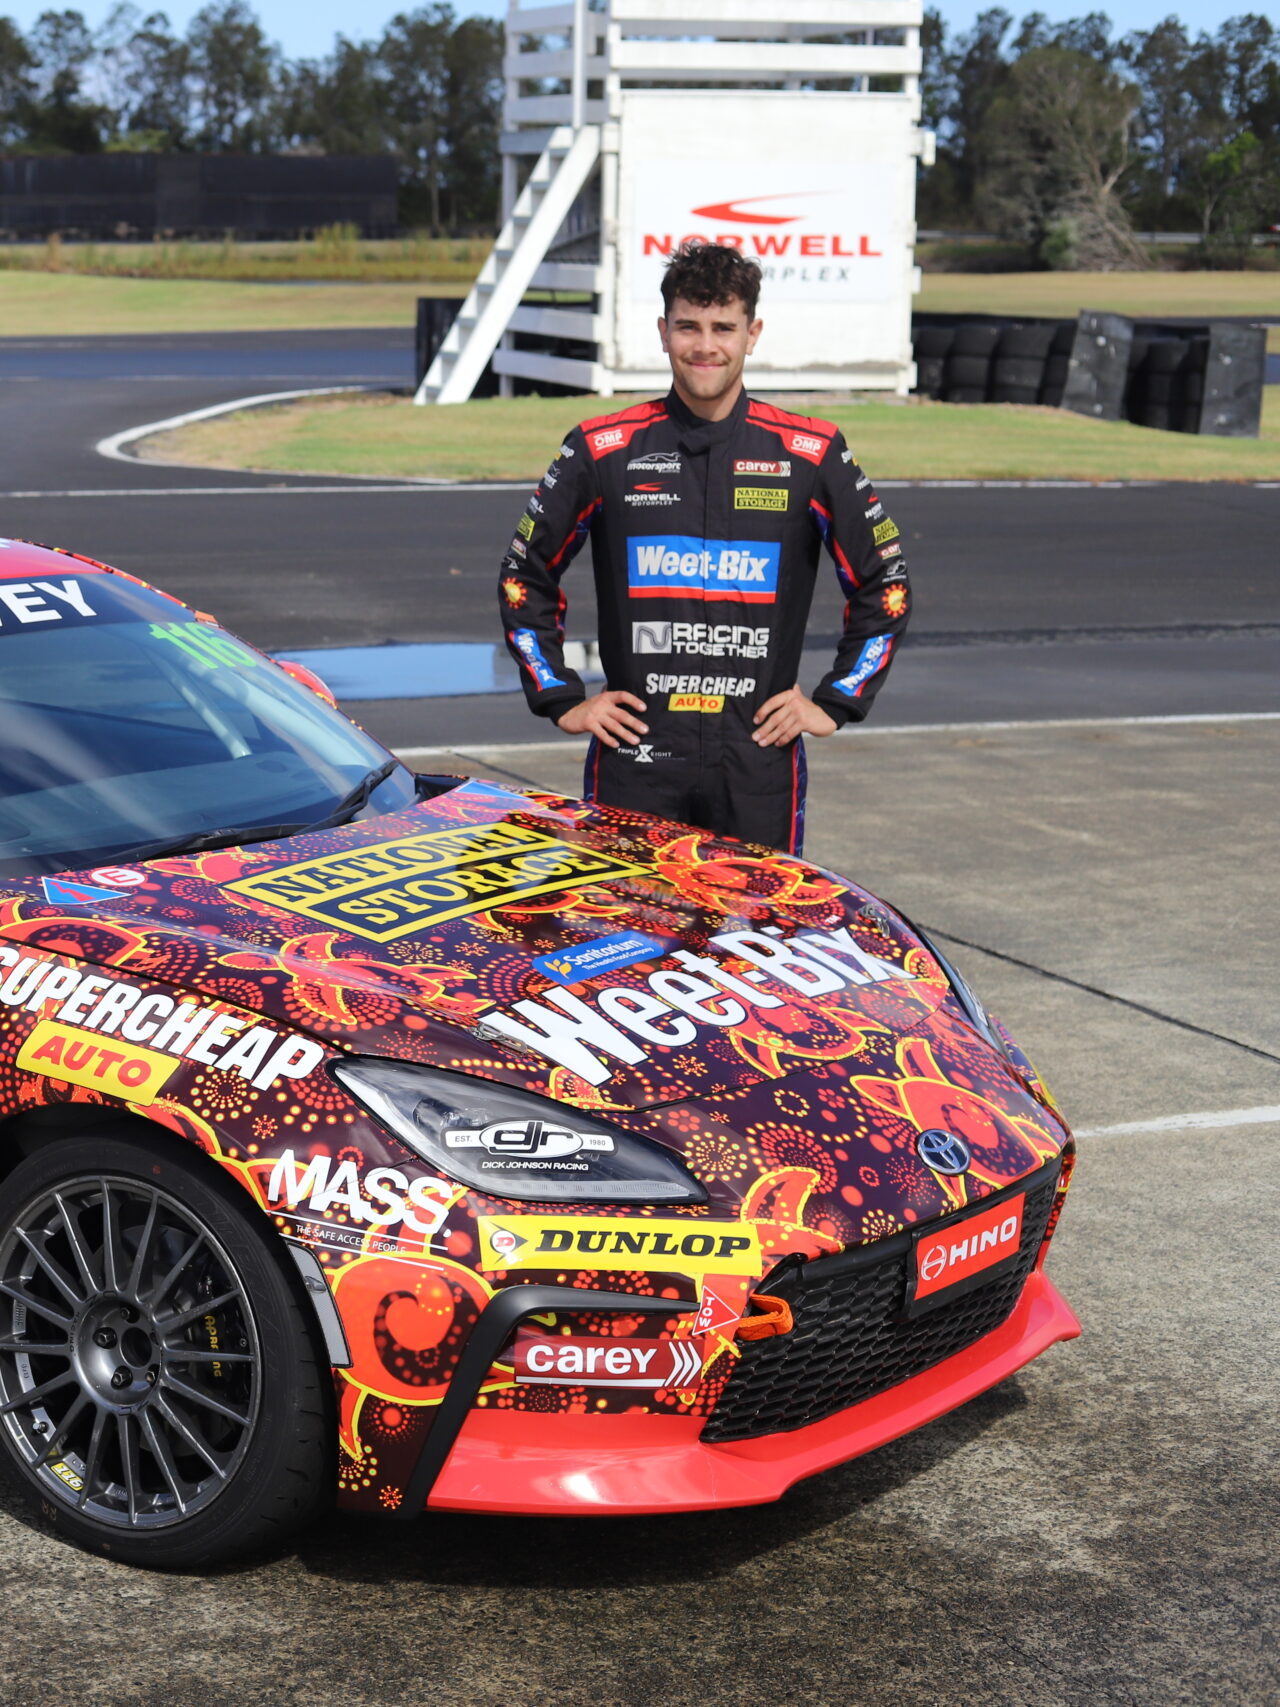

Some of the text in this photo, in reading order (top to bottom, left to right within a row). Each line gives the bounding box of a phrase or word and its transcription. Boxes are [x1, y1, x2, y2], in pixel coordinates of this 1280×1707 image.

[594, 432, 624, 447] OMP
[791, 437, 822, 452] OMP
[624, 493, 681, 502] NORWELL
[737, 489, 787, 498] NATIONAL
[739, 498, 785, 508] STORAGE
[637, 544, 769, 582] Weet-Bix
[149, 622, 257, 669] 116
[673, 622, 770, 646] RACING
[673, 641, 769, 659] TOGETHER
[646, 672, 756, 698] SUPERCHEAP
[674, 696, 719, 710] AUTO
[251, 826, 547, 903] NATIONAL
[337, 847, 612, 925] STORAGE
[563, 939, 644, 966] Sanitarium
[483, 926, 917, 1087] Weet-Bix
[31, 1034, 153, 1088] AUTO
[455, 1135, 473, 1143] EST.
[589, 1139, 607, 1147] 1980
[481, 1161, 589, 1171] DICK JOHNSON RACING
[267, 1148, 454, 1234] MASS
[296, 1224, 407, 1255] THE SAFE ACCESS PEOPLE
[535, 1229, 751, 1258] DUNLOP
[949, 1214, 1019, 1267] HINO
[699, 1296, 716, 1328] TOW
[526, 1343, 658, 1374] carey
[54, 1463, 84, 1488] 116
